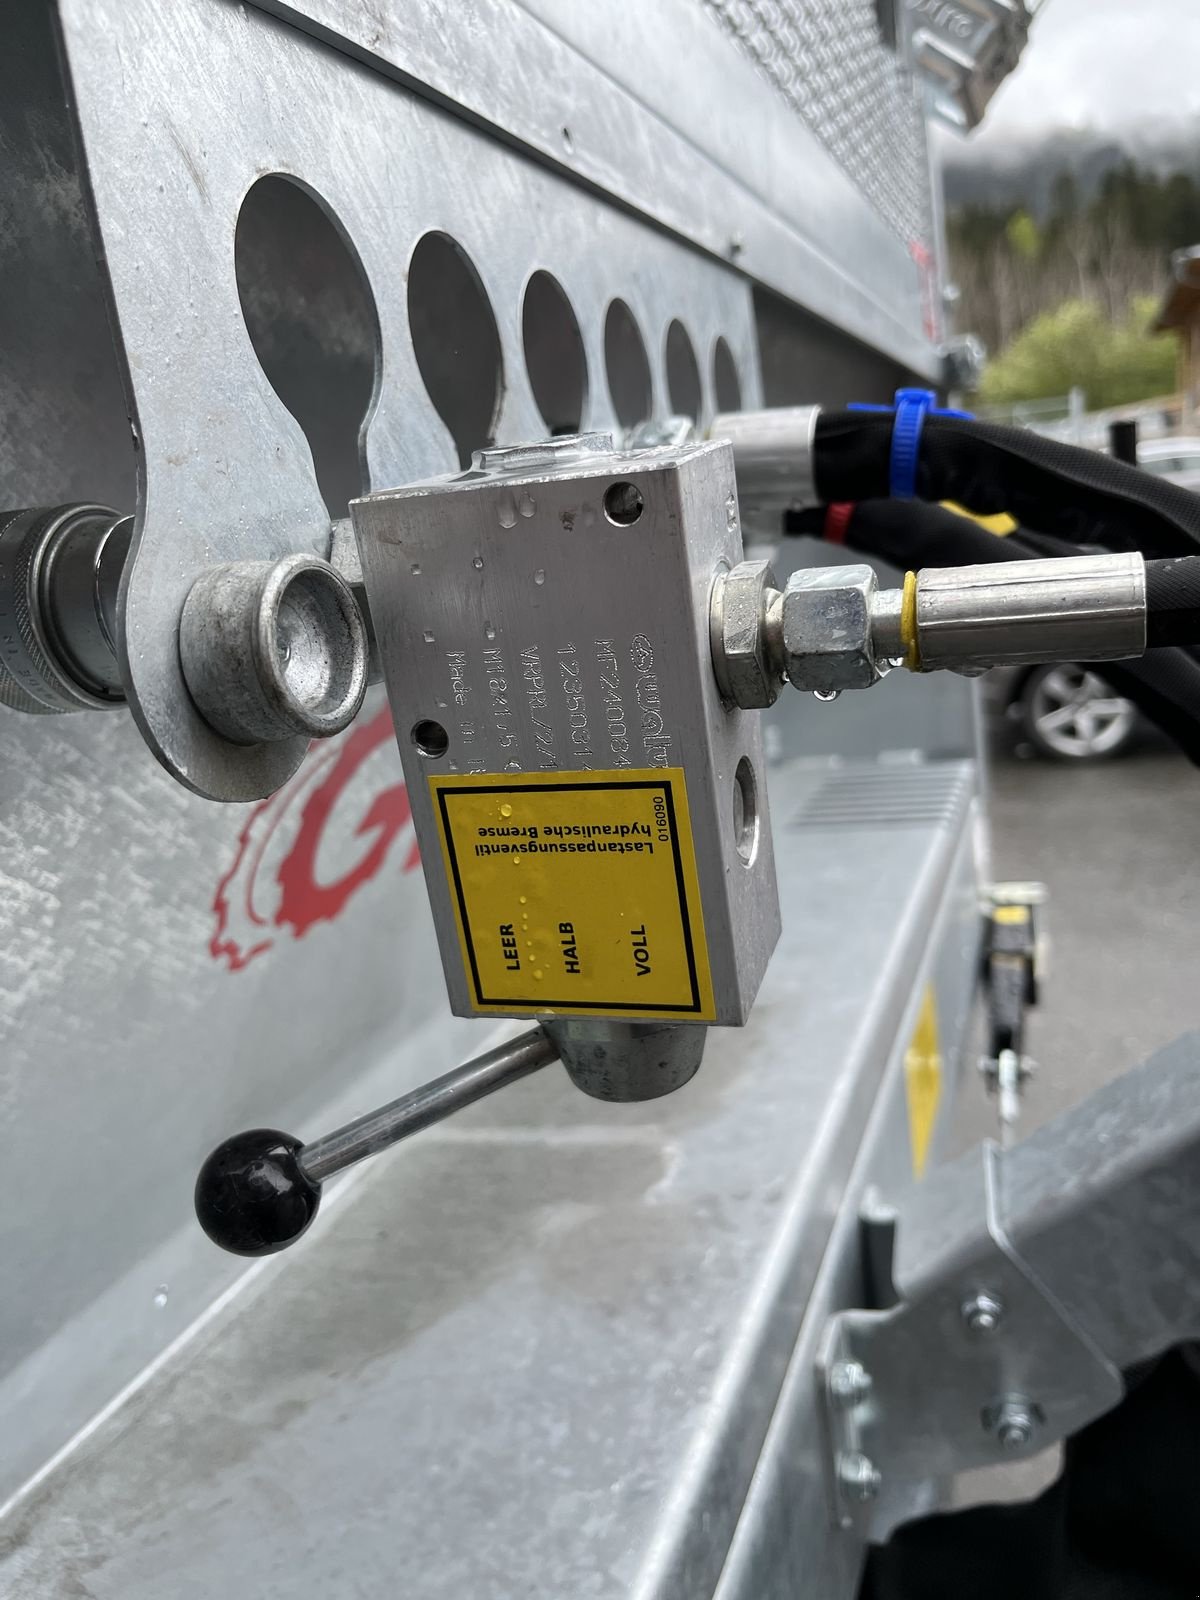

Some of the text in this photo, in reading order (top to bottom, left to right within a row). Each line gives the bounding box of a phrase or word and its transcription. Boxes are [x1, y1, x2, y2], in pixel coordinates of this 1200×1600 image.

[446, 650, 472, 706] Made
[478, 822, 652, 838] hydraulische Bremse
[653, 796, 669, 842] 016090
[475, 841, 654, 856] Lastanpassungsventil
[500, 923, 521, 971] LEER
[559, 922, 581, 974] HALB
[631, 924, 651, 977] VOLL
